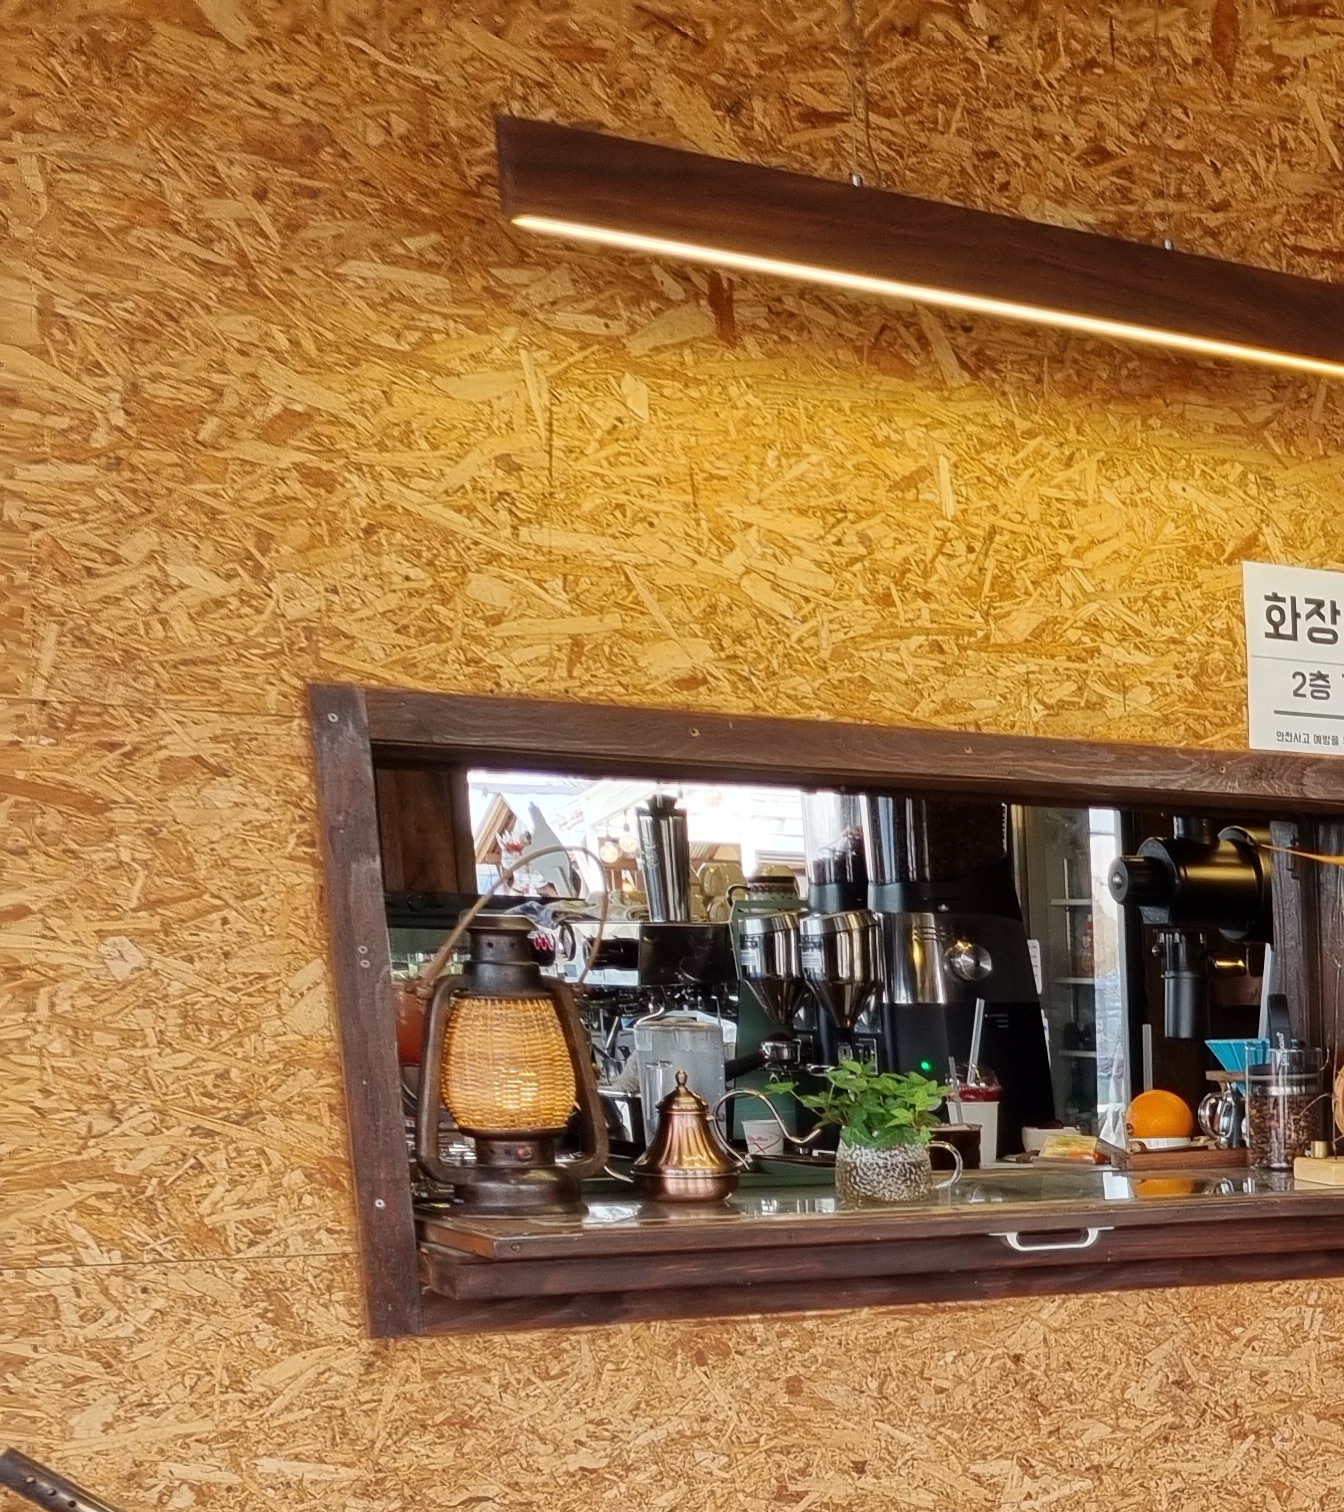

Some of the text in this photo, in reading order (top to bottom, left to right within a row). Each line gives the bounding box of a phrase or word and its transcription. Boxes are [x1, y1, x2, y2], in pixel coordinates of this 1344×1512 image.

[1291, 671, 1332, 701] 2층
[1276, 731, 1310, 744] 안전사고
[1314, 734, 1339, 746] 예방을
